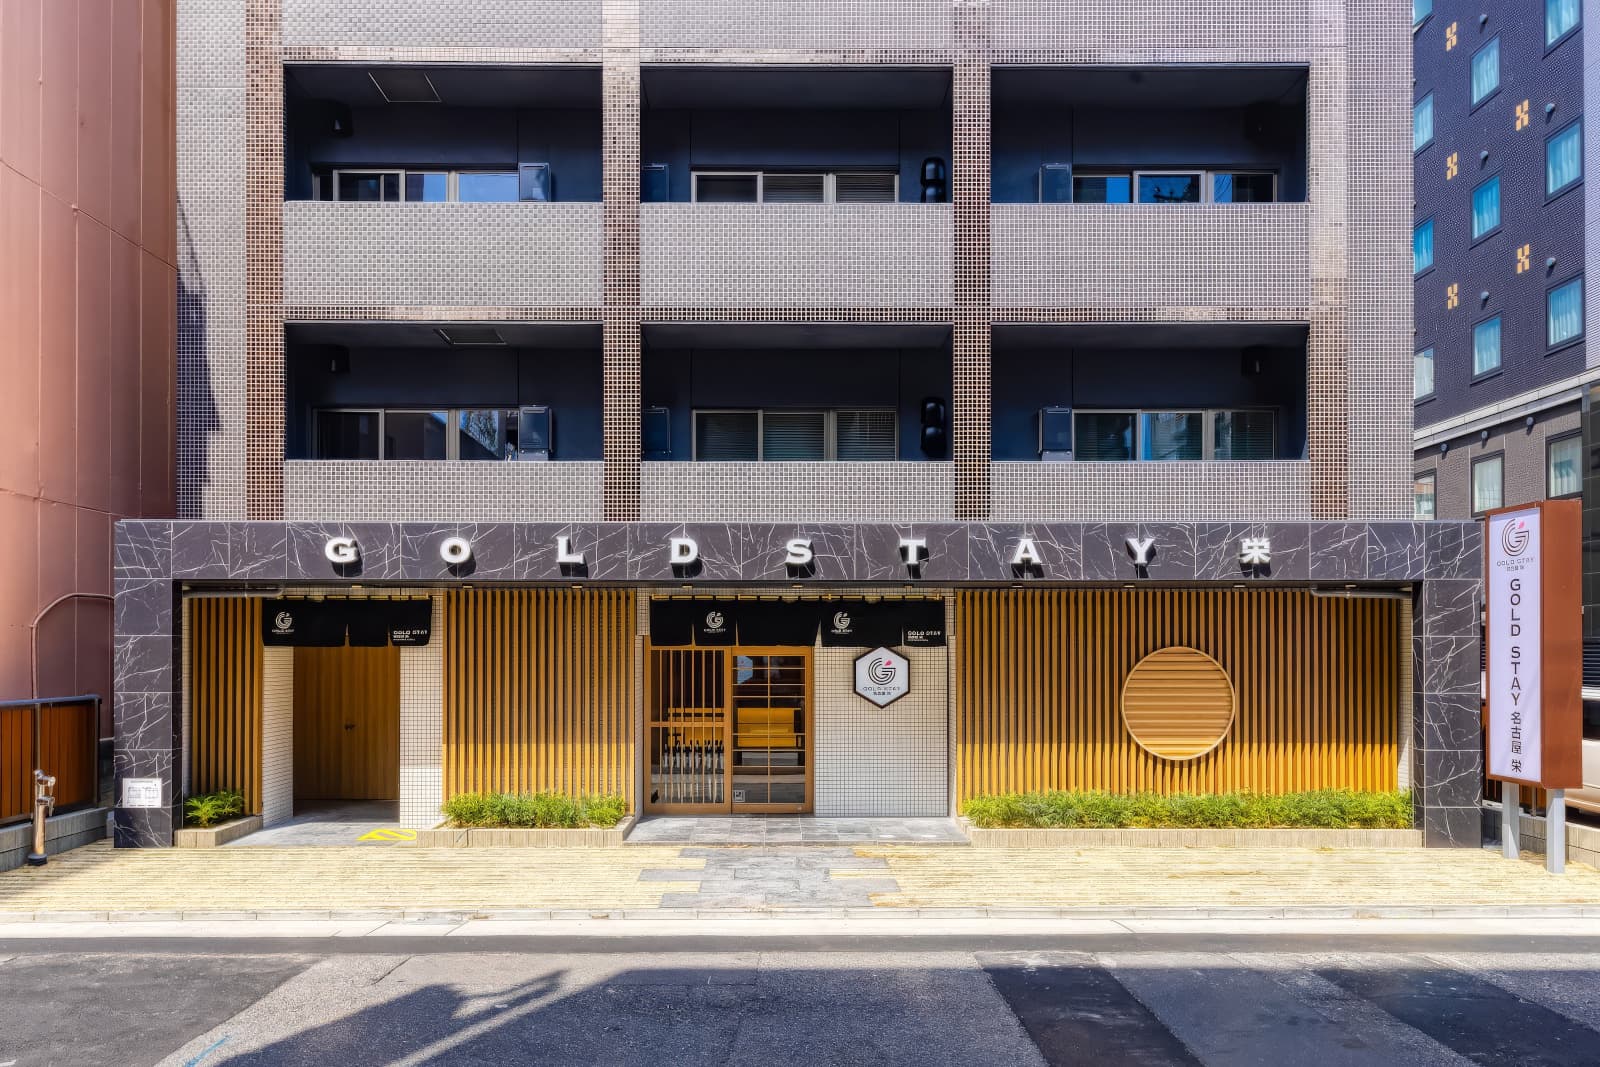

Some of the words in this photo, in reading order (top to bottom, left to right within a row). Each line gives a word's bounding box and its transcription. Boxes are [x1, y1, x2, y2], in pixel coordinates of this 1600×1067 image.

[1239, 537, 1272, 564] 栄
[1510, 578, 1521, 638] GOLD
[1510, 646, 1521, 706] STAY
